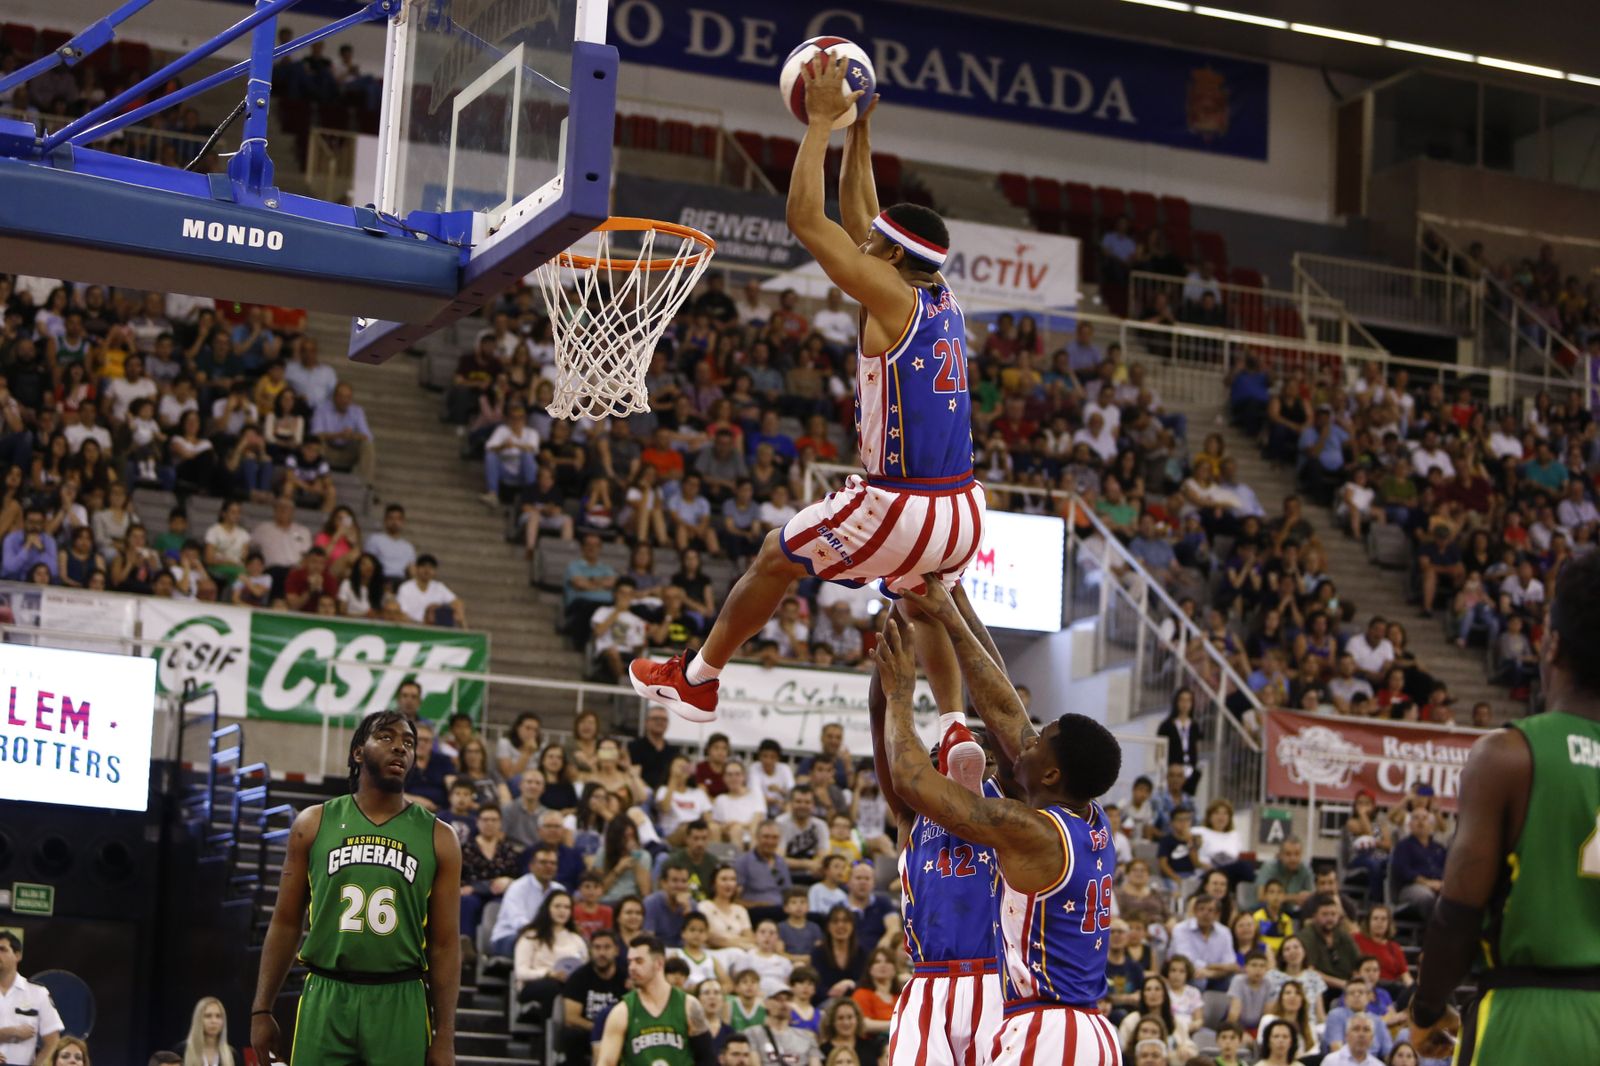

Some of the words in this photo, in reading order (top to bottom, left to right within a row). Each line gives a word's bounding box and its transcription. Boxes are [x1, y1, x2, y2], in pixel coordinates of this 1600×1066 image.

[685, 9, 779, 66] DE
[182, 218, 284, 251] MONDO
[680, 206, 804, 248] BIENVENID
[932, 338, 968, 394] 21
[166, 641, 242, 674] CSIF
[261, 628, 473, 716] CSIF
[8, 686, 90, 740] LEM
[1382, 735, 1470, 763] Restaur
[346, 835, 403, 850] WASHINGTON
[1266, 819, 1285, 843] A
[328, 844, 418, 884] GENERALS
[936, 844, 977, 879] 42
[339, 883, 399, 936] 26
[1081, 873, 1112, 933] 19
